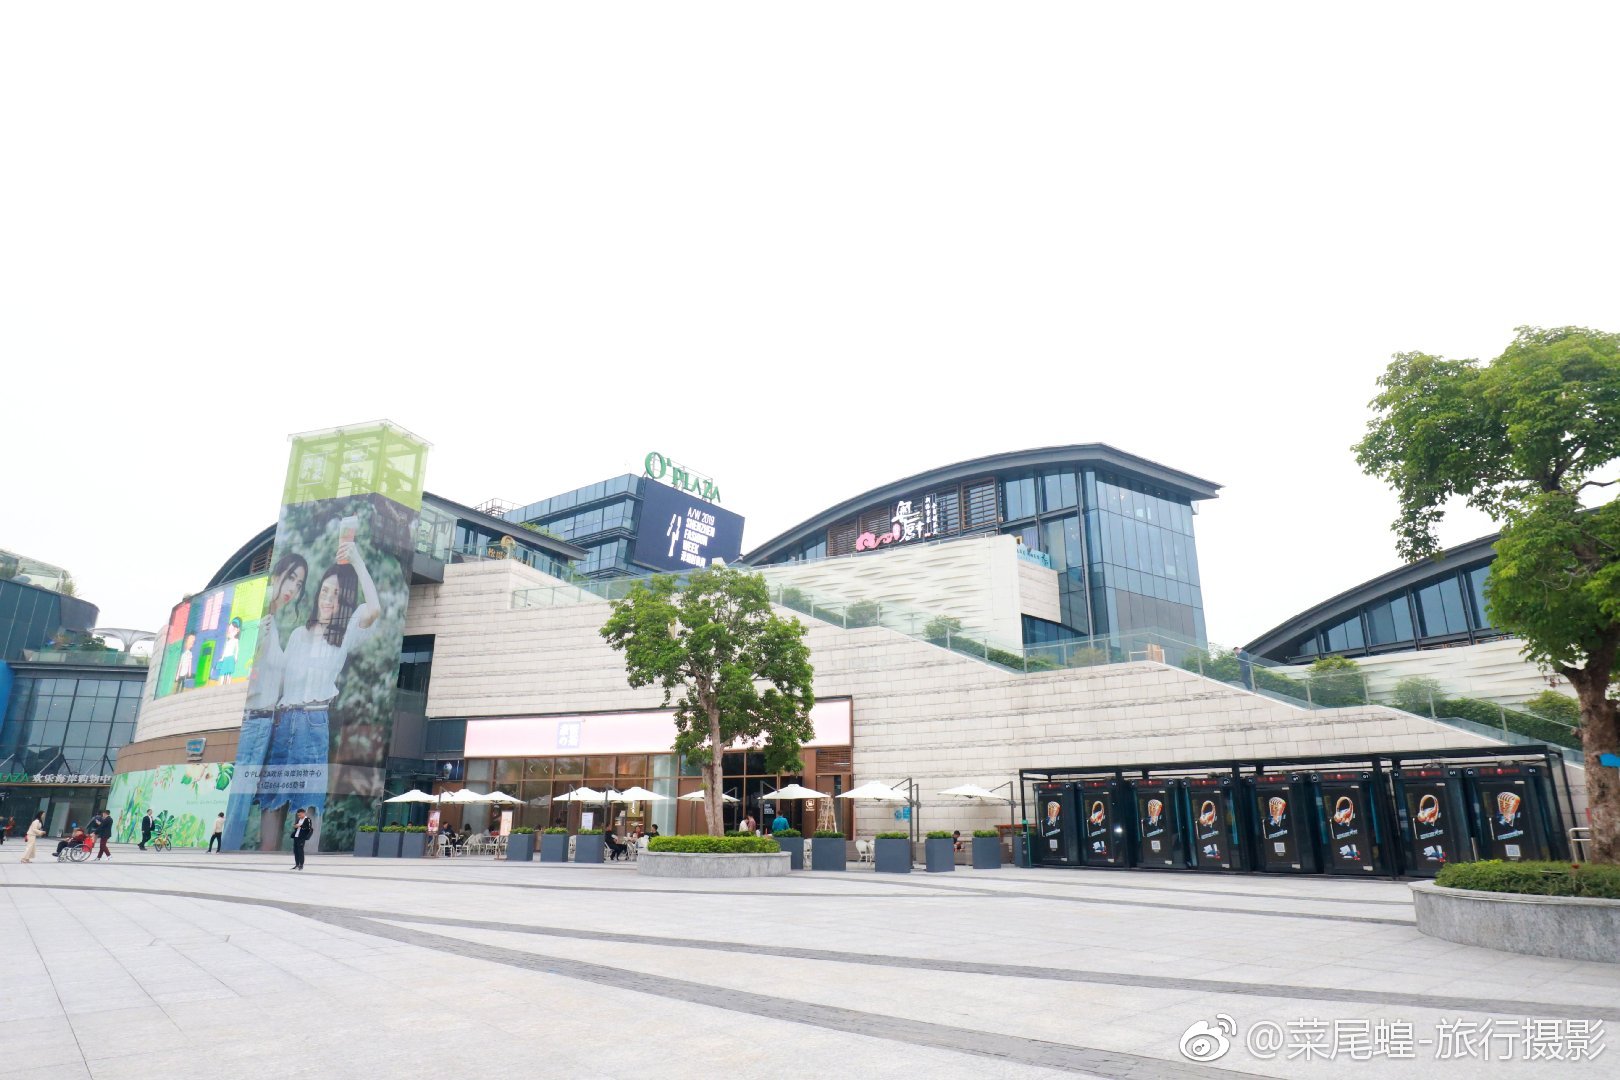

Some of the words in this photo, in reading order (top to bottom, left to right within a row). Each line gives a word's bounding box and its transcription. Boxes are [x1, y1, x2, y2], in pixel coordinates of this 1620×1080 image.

[645, 452, 721, 503] O'PLAZA
[686, 517, 716, 538] SHENZHEN
[701, 512, 715, 526] 2019
[682, 539, 700, 555] WEEK
[683, 528, 708, 547] FASHION
